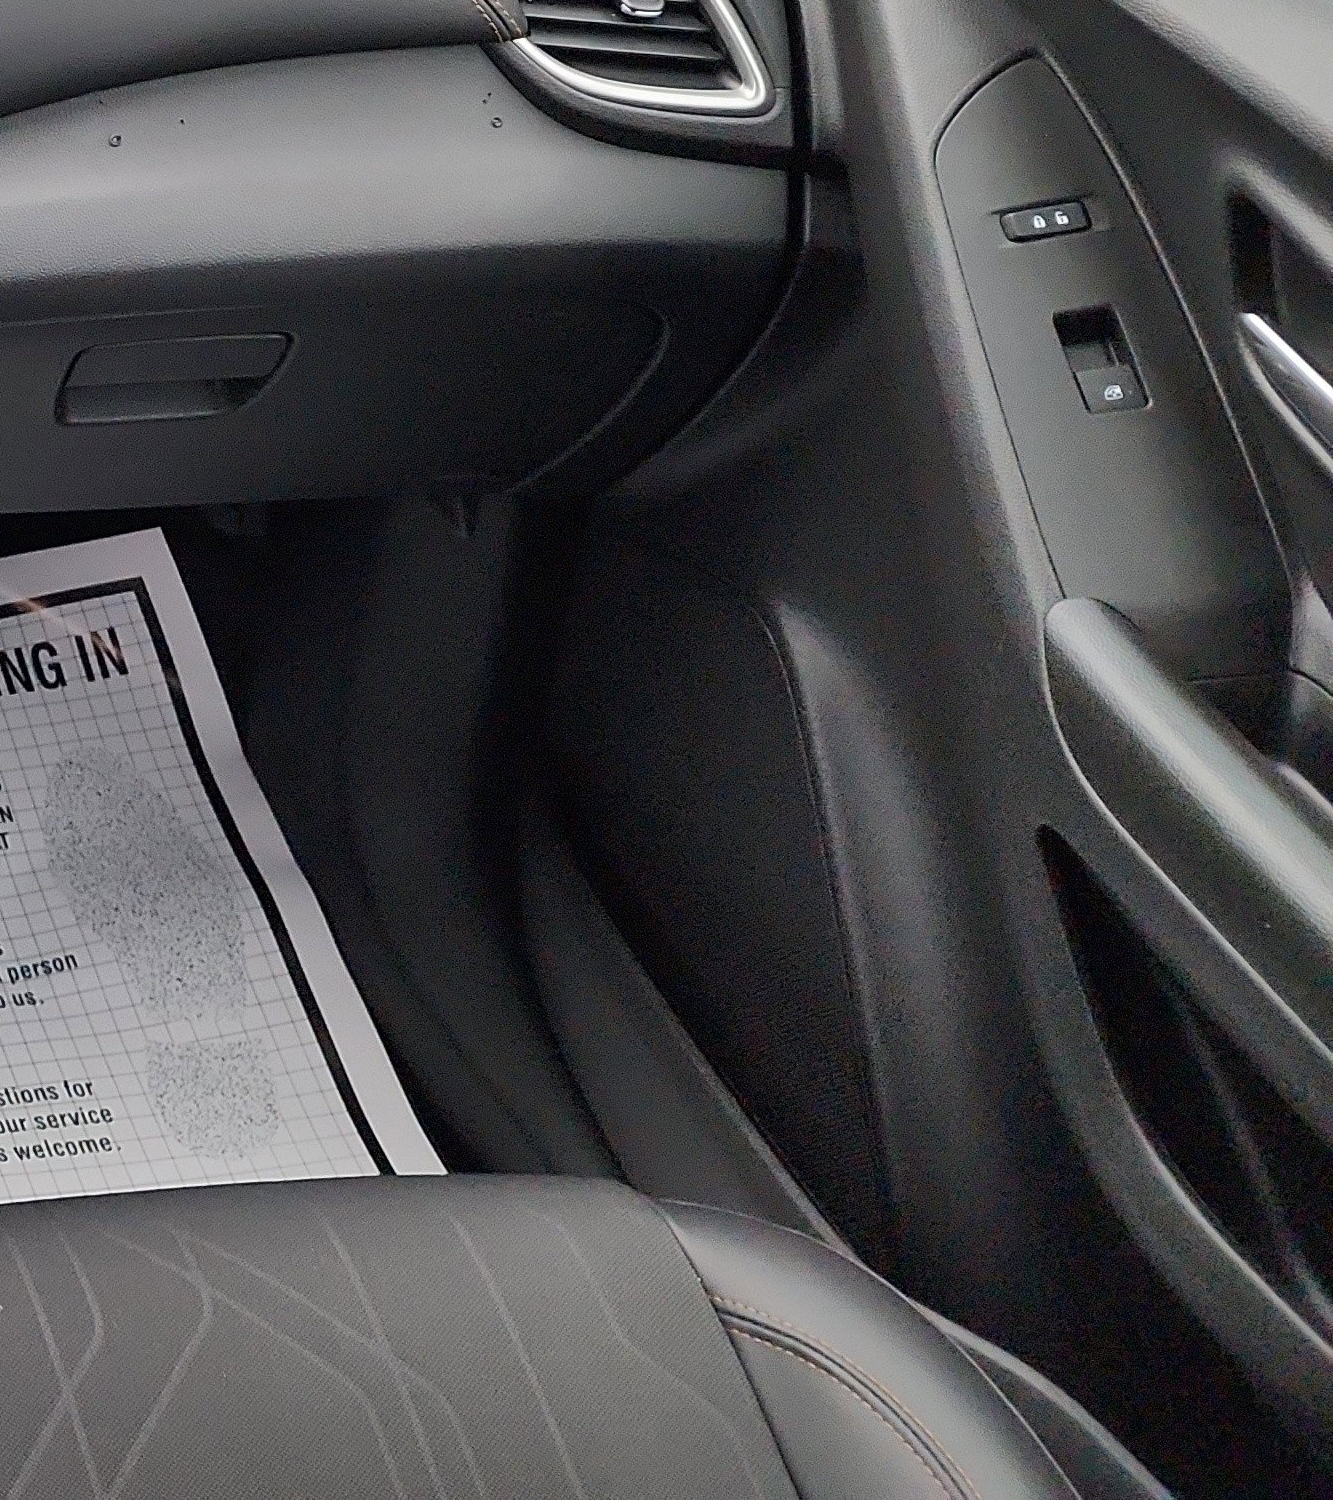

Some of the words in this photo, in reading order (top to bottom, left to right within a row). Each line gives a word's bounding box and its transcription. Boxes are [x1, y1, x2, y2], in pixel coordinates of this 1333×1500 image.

[74, 627, 131, 683] IN
[6, 954, 79, 985] person
[10, 990, 45, 1007] us.
[63, 1079, 94, 1098] for
[33, 1106, 114, 1131] service
[13, 1136, 123, 1161] welcome.
